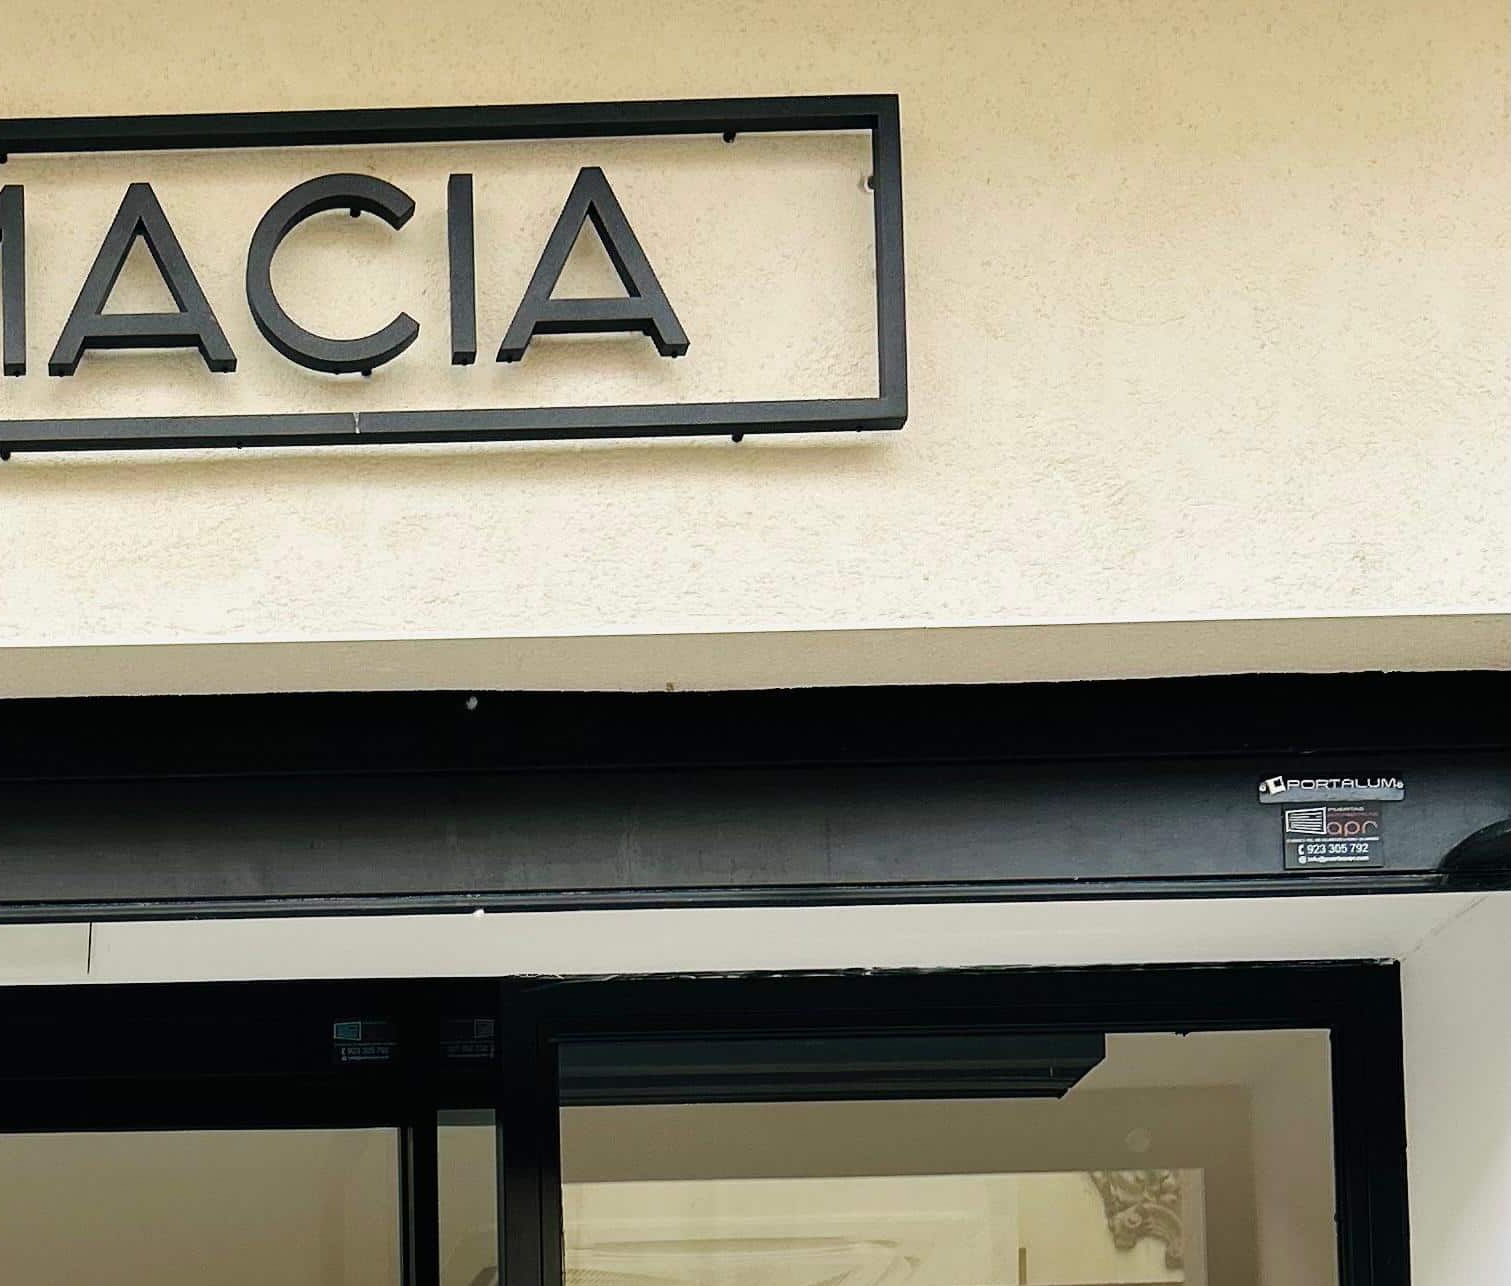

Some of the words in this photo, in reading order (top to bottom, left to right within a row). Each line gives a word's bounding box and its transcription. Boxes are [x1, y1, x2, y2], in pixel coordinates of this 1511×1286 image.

[1287, 777, 1397, 790] PORTALUM
[1306, 843, 1326, 854] 923
[1328, 843, 1348, 853] 305
[1350, 843, 1369, 853] 792
